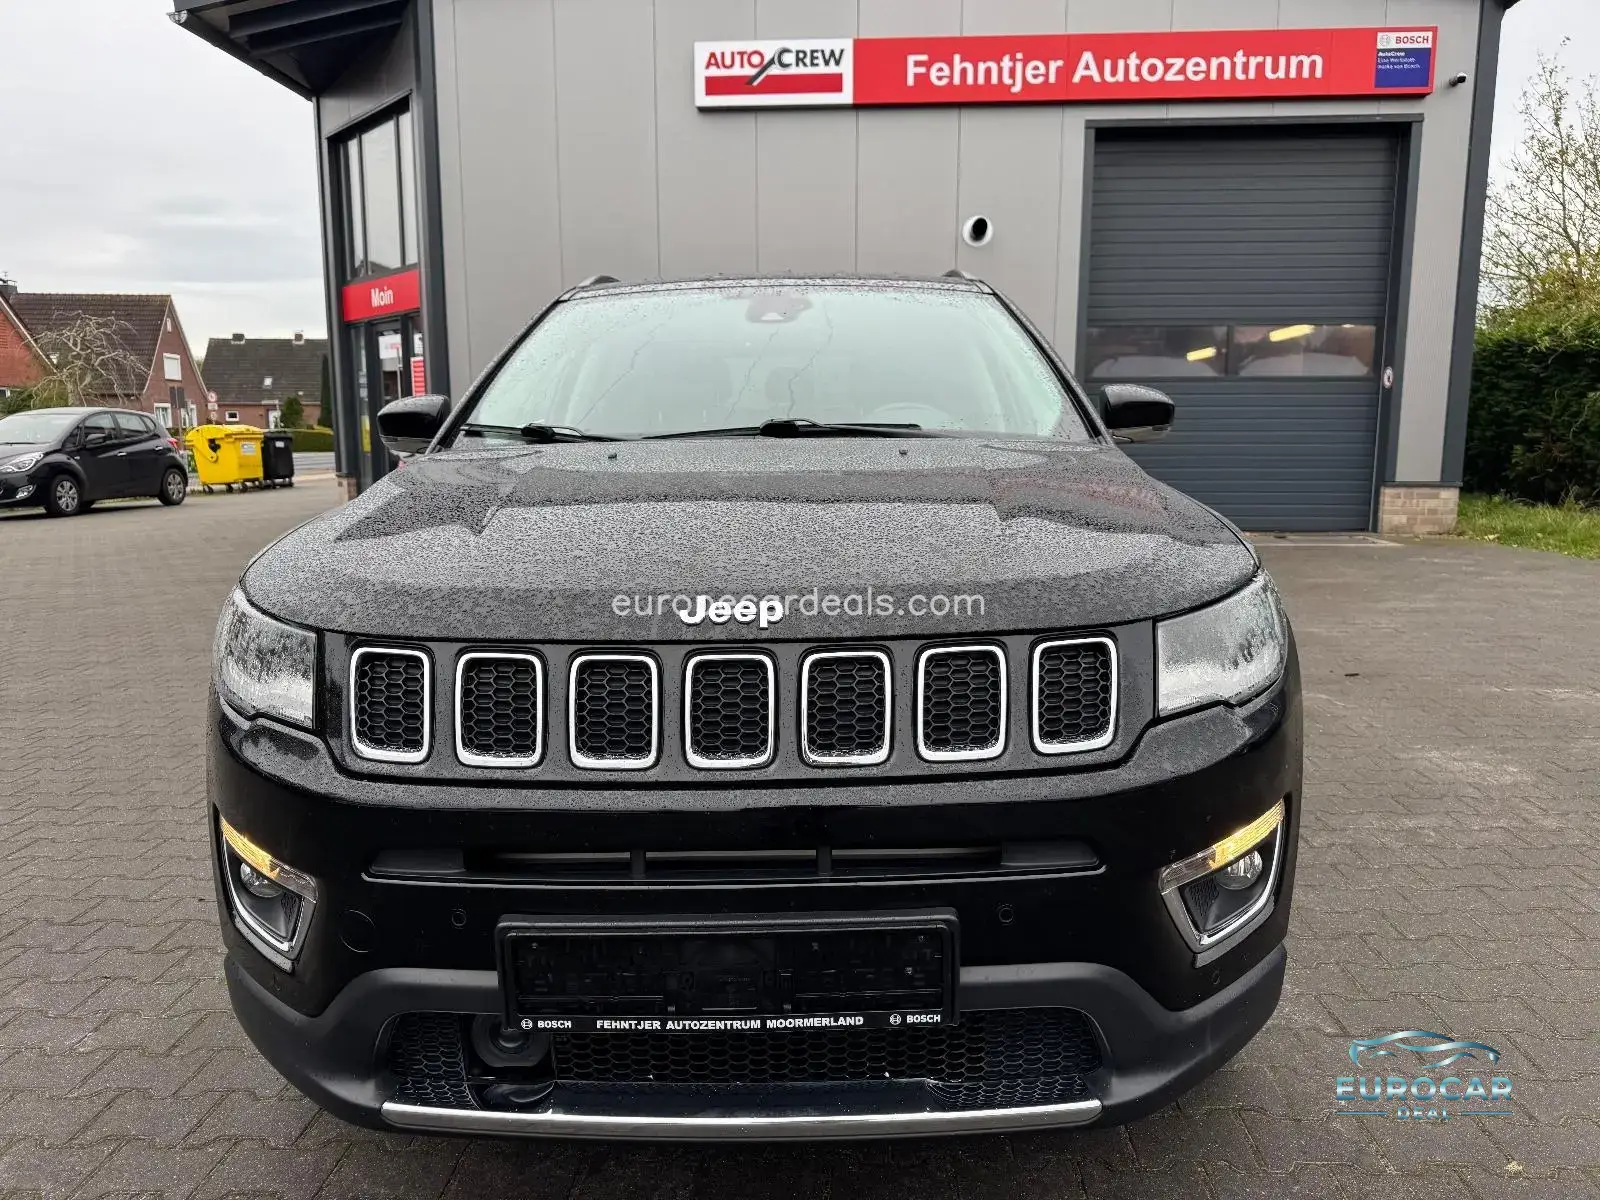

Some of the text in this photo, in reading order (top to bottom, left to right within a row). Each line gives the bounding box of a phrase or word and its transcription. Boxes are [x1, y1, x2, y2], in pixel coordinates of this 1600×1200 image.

[1395, 35, 1429, 44] BOSCH
[705, 47, 844, 70] AUTO CREW
[906, 49, 1323, 93] Fehntjer Autozentrum
[370, 286, 394, 307] Moin
[679, 595, 784, 629] Jeep
[536, 1019, 573, 1029] BOSCH
[596, 1016, 865, 1030] FEHNTJER AUTOZENTRUM MOORMERLAND
[906, 1013, 942, 1024] BOSCH
